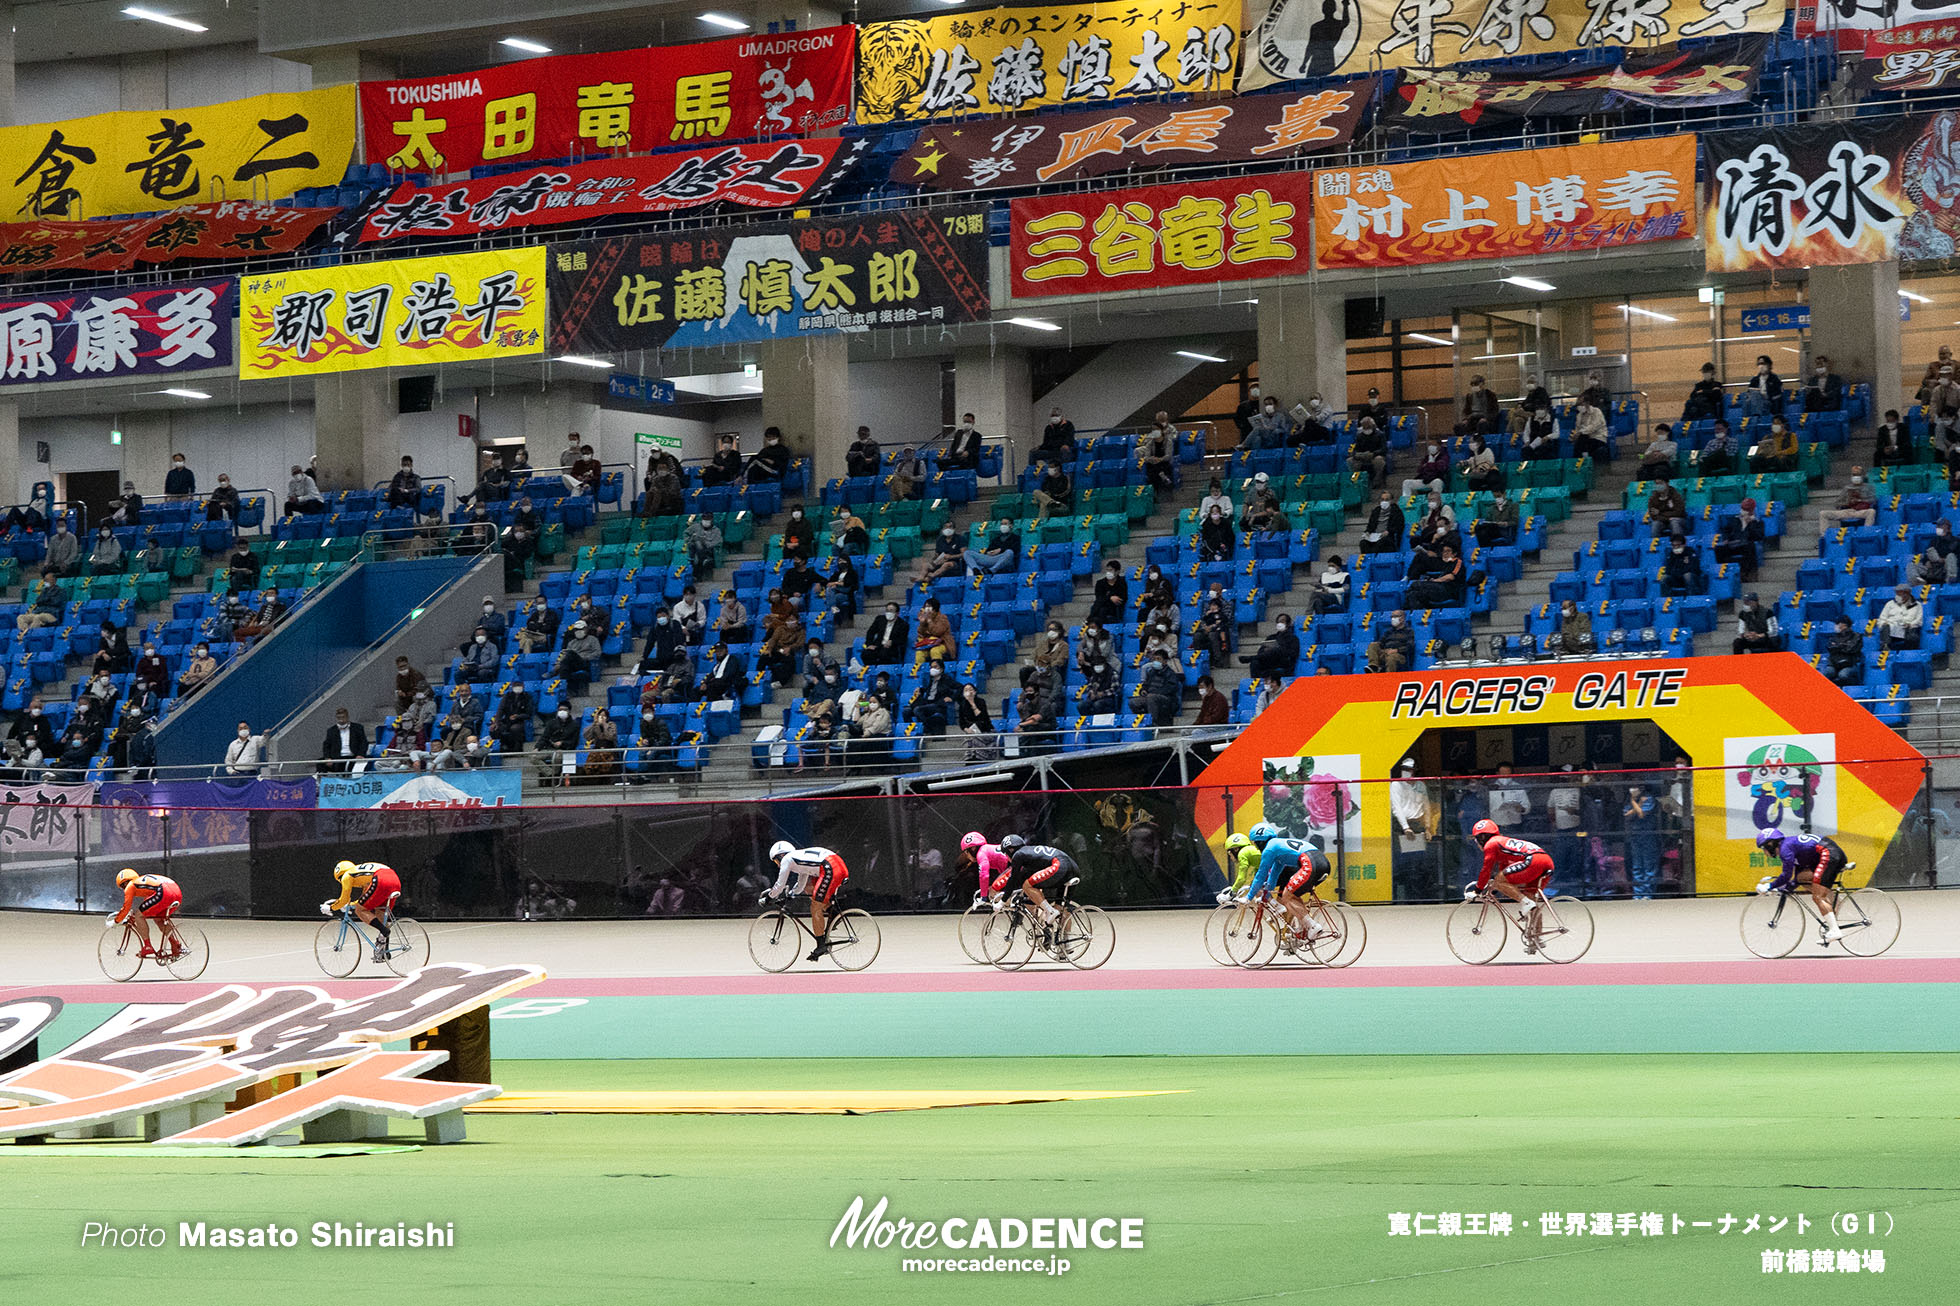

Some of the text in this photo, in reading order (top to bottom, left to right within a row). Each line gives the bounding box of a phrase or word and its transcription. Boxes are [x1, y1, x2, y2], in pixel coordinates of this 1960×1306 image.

[739, 34, 834, 57] UMADRGON
[949, 2, 1218, 41] 輪界のエンターティナー
[919, 23, 1235, 110] 佐藤慎太郎
[387, 78, 483, 105] TOKUSHIMA
[385, 70, 733, 171] 太田竜馬
[1036, 88, 1355, 182] 皿屋豊
[15, 112, 321, 216] 倉竜二
[966, 124, 1046, 188] 伊勢
[575, 177, 635, 192] 令和の
[1318, 168, 1394, 197] 闘魂
[1331, 169, 1683, 242] 村上博幸
[1716, 140, 1905, 257] 清水
[639, 221, 899, 268] 競輪は 俺の人生
[943, 213, 984, 237] 78期
[1022, 190, 1297, 284] 三谷竜生
[248, 278, 287, 294] 神奈川
[556, 251, 588, 272] 福島
[613, 249, 921, 327] 佐藤慎太郎
[0, 287, 217, 380] 原康多
[258, 270, 525, 358] 郡司浩平
[839, 310, 878, 328] 熊本県
[880, 306, 945, 324] 後援会一同
[1390, 668, 1688, 719] RACERS' GATE
[1255, 827, 1264, 836] 4
[1286, 839, 1304, 851] 4
